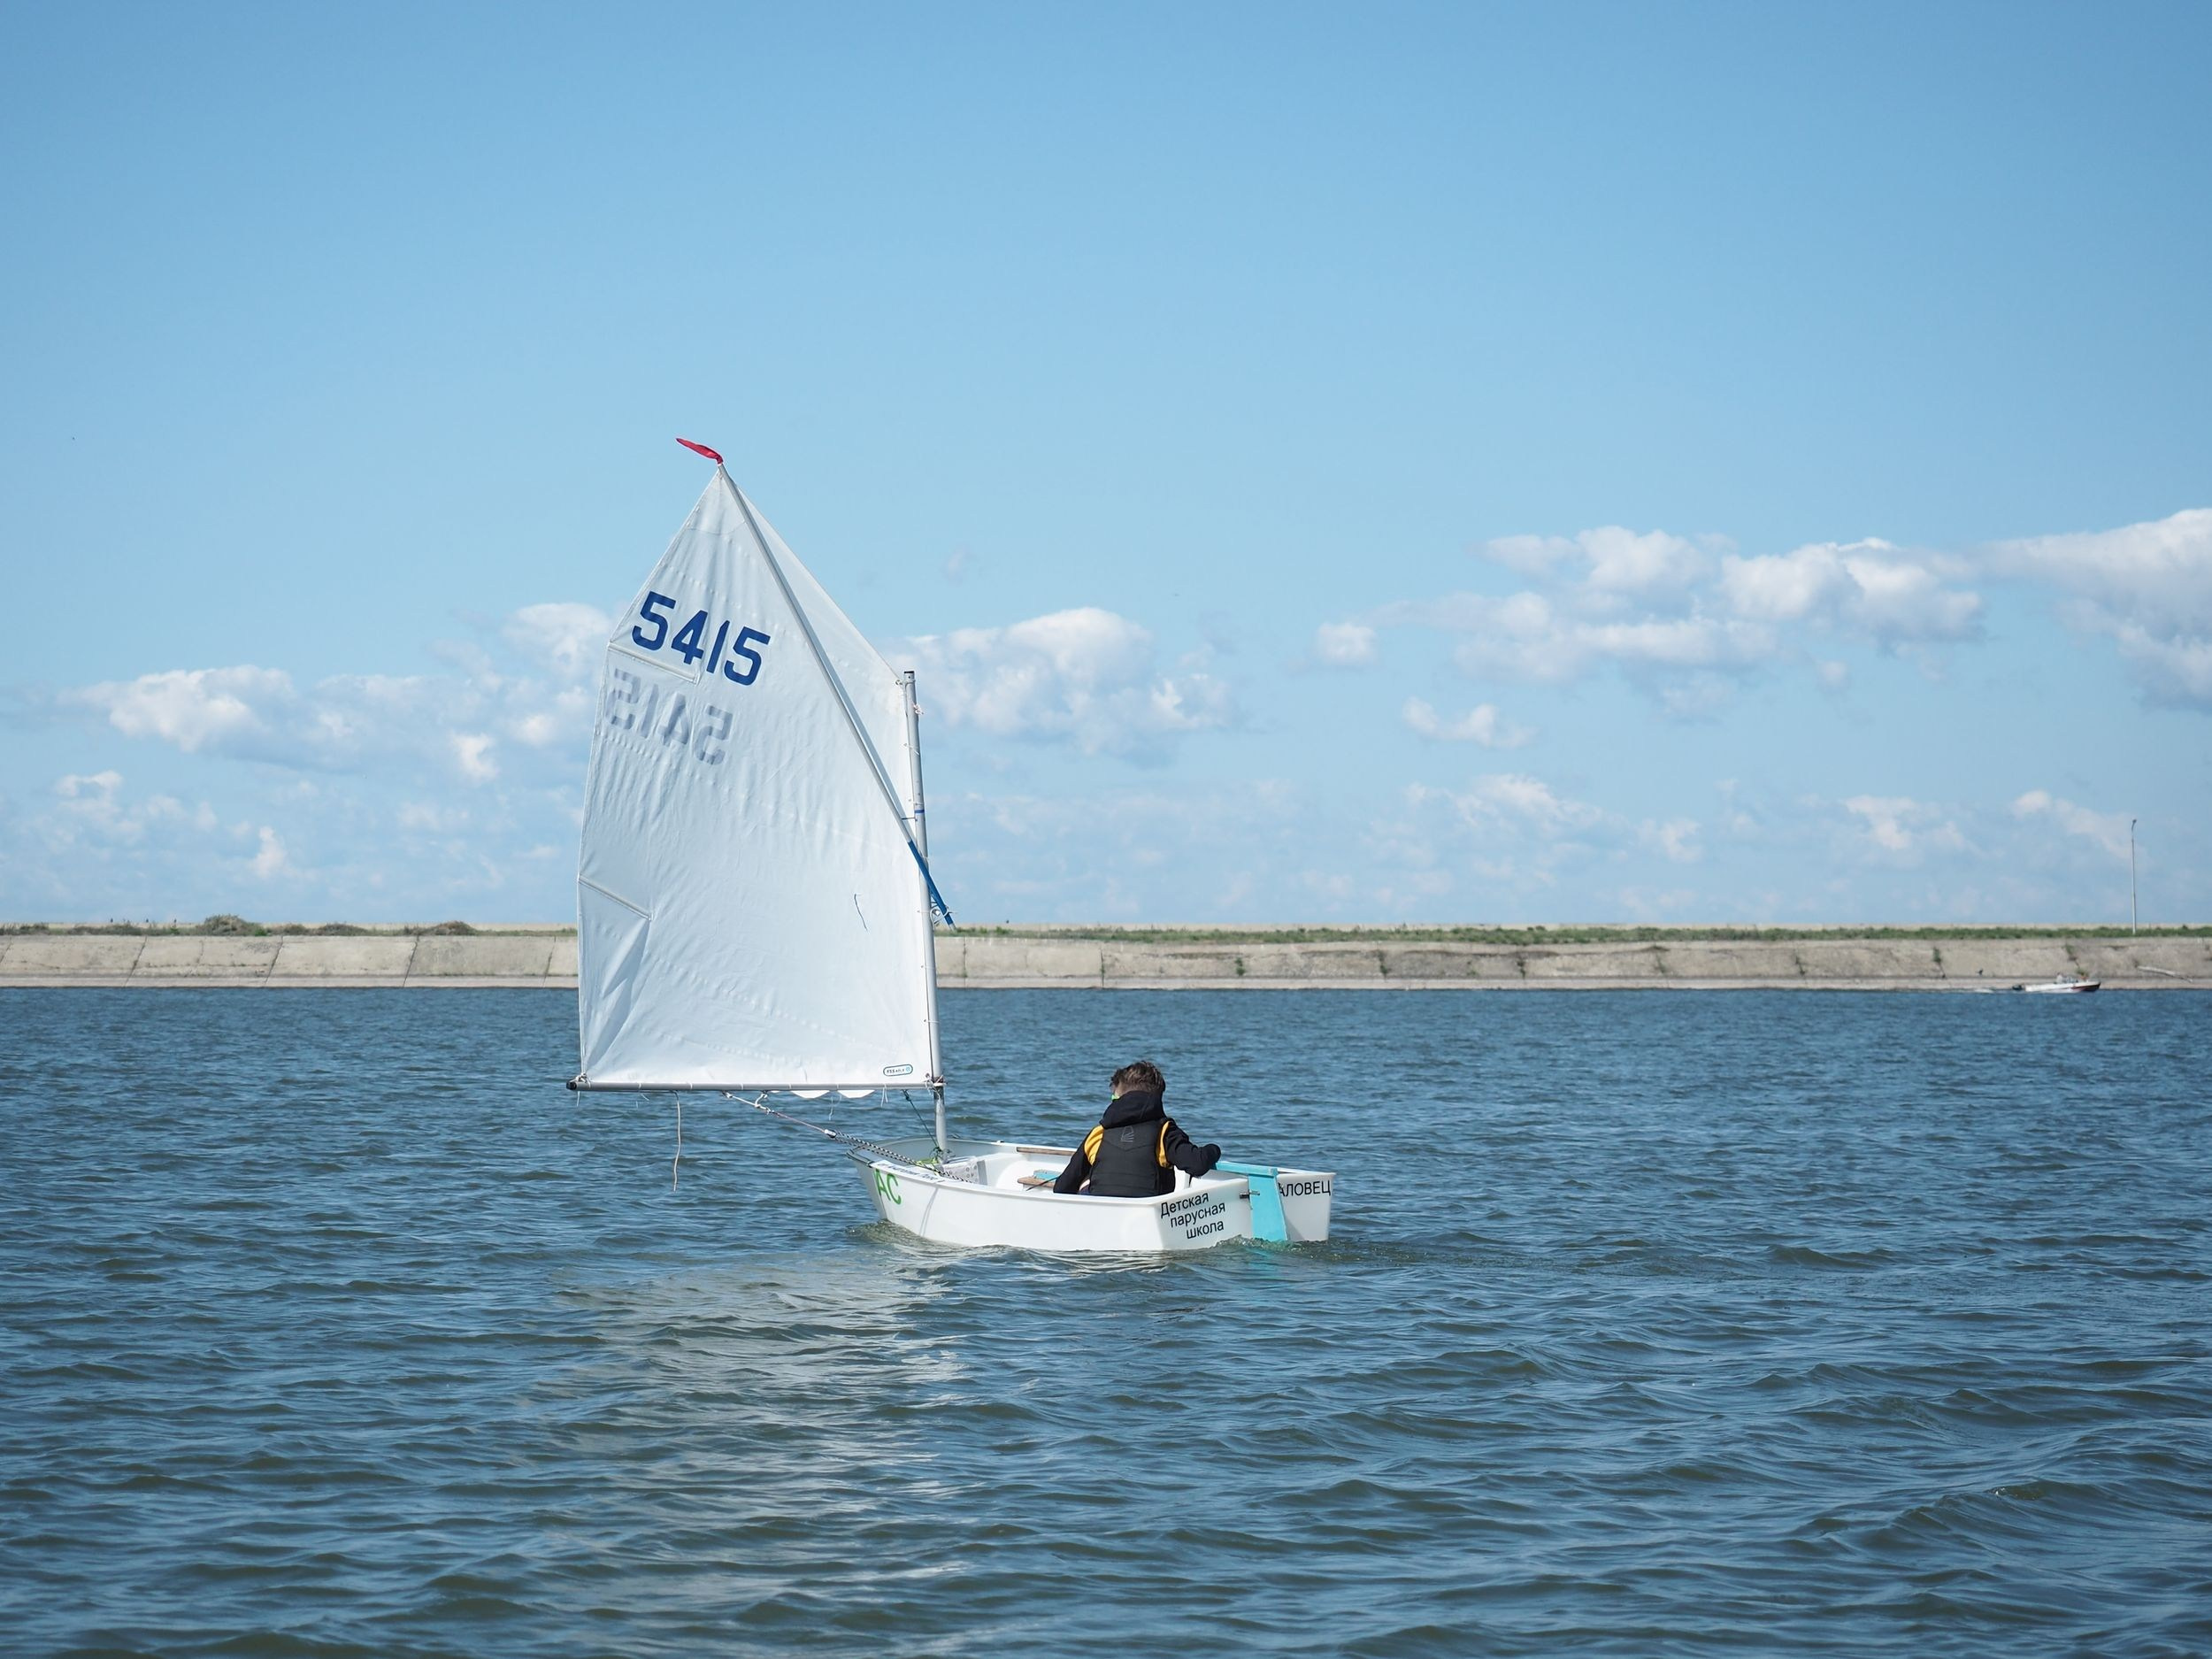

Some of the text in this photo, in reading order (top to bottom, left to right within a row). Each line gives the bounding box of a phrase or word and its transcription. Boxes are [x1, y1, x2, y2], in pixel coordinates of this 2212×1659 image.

[632, 591, 771, 686] 5415
[1161, 1193, 1209, 1218] Детская
[1171, 1203, 1225, 1228] парусная
[1187, 1221, 1224, 1239] школа
